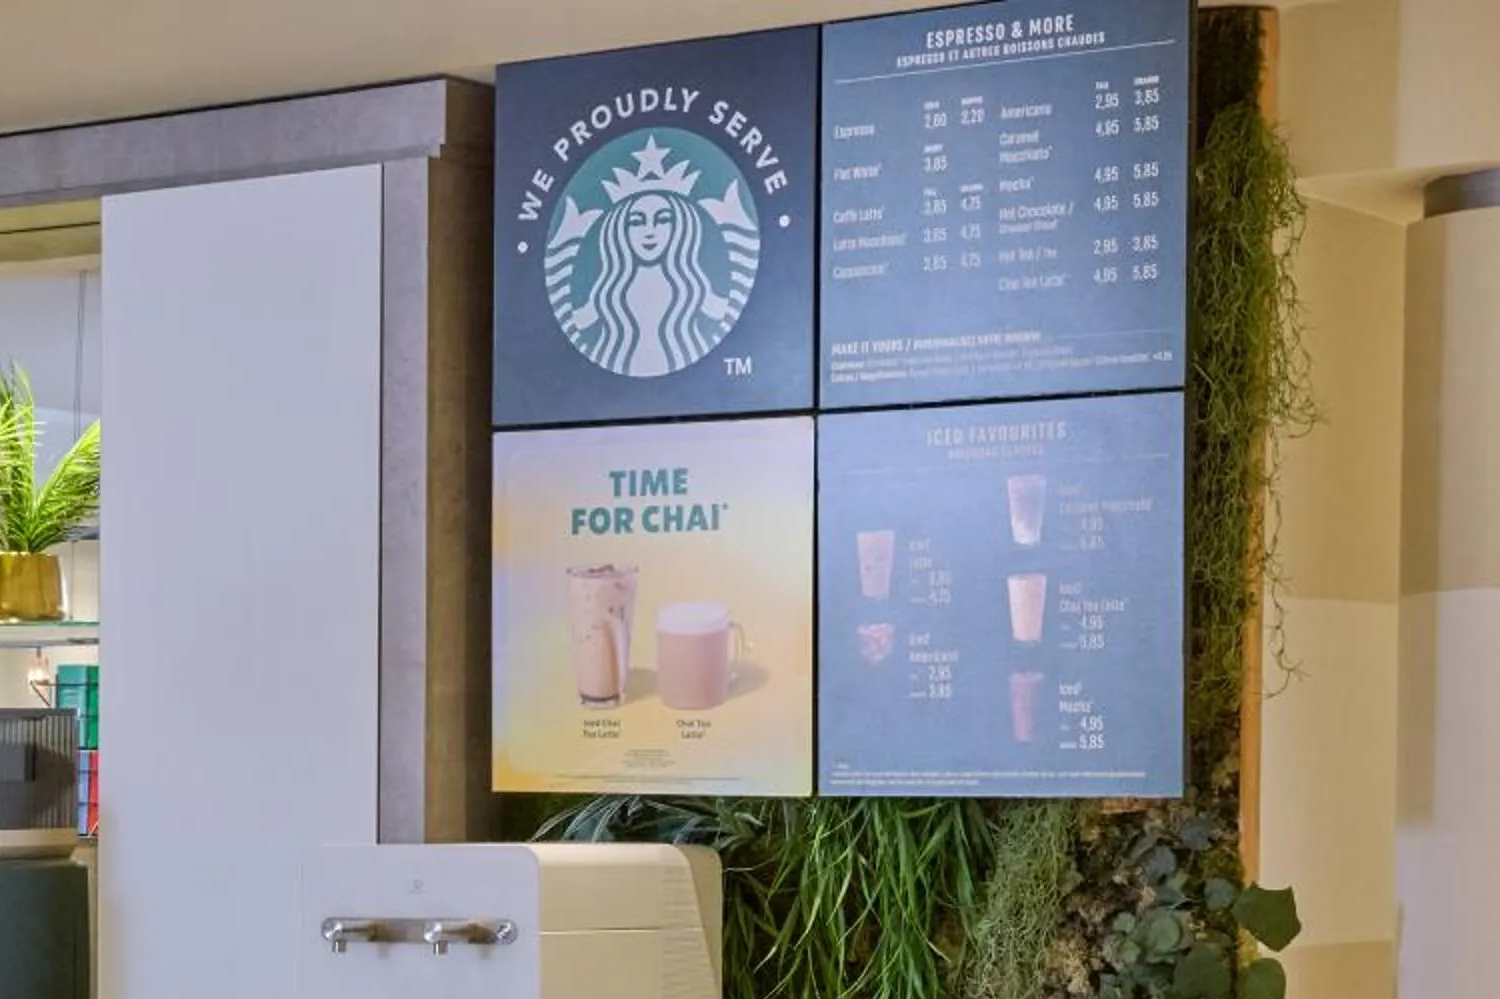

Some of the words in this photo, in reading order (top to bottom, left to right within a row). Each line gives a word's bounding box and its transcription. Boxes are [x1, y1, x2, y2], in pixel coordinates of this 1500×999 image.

[926, 22, 1005, 49] ESPRESSO
[1011, 21, 1023, 39] &
[1029, 14, 1074, 35] MORE
[518, 168, 556, 221] WE
[553, 87, 700, 162] PROUDLY
[708, 100, 788, 195] SERVE
[724, 355, 751, 376] TM
[609, 468, 689, 497] TIME
[571, 507, 634, 536] FOR
